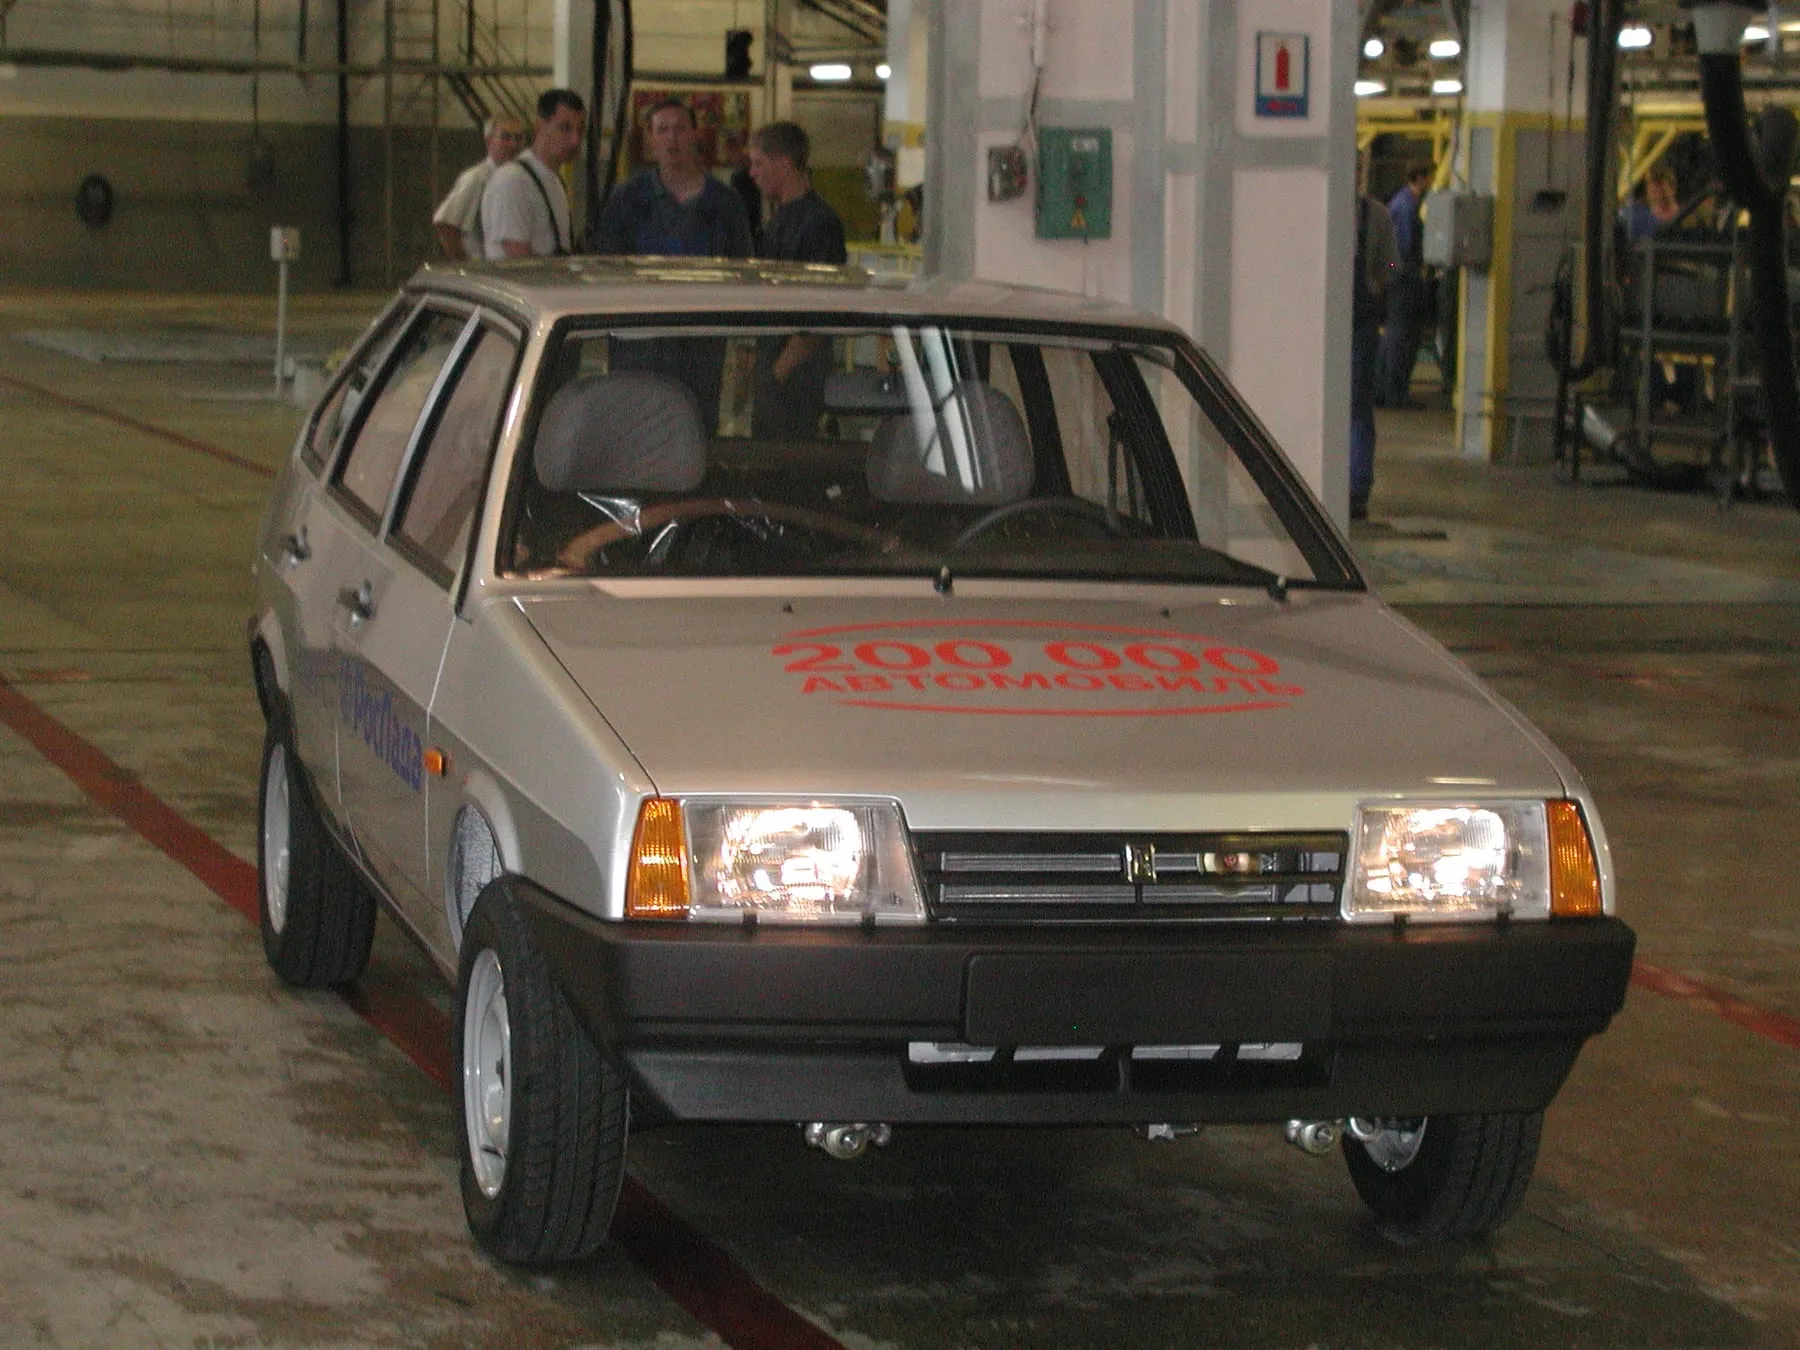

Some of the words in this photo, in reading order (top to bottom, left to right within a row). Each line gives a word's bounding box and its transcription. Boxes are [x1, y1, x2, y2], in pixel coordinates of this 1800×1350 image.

[771, 640, 1013, 674] 200
[1044, 640, 1280, 676] 000
[801, 671, 1305, 697] АВТОМОБИЛЬ
